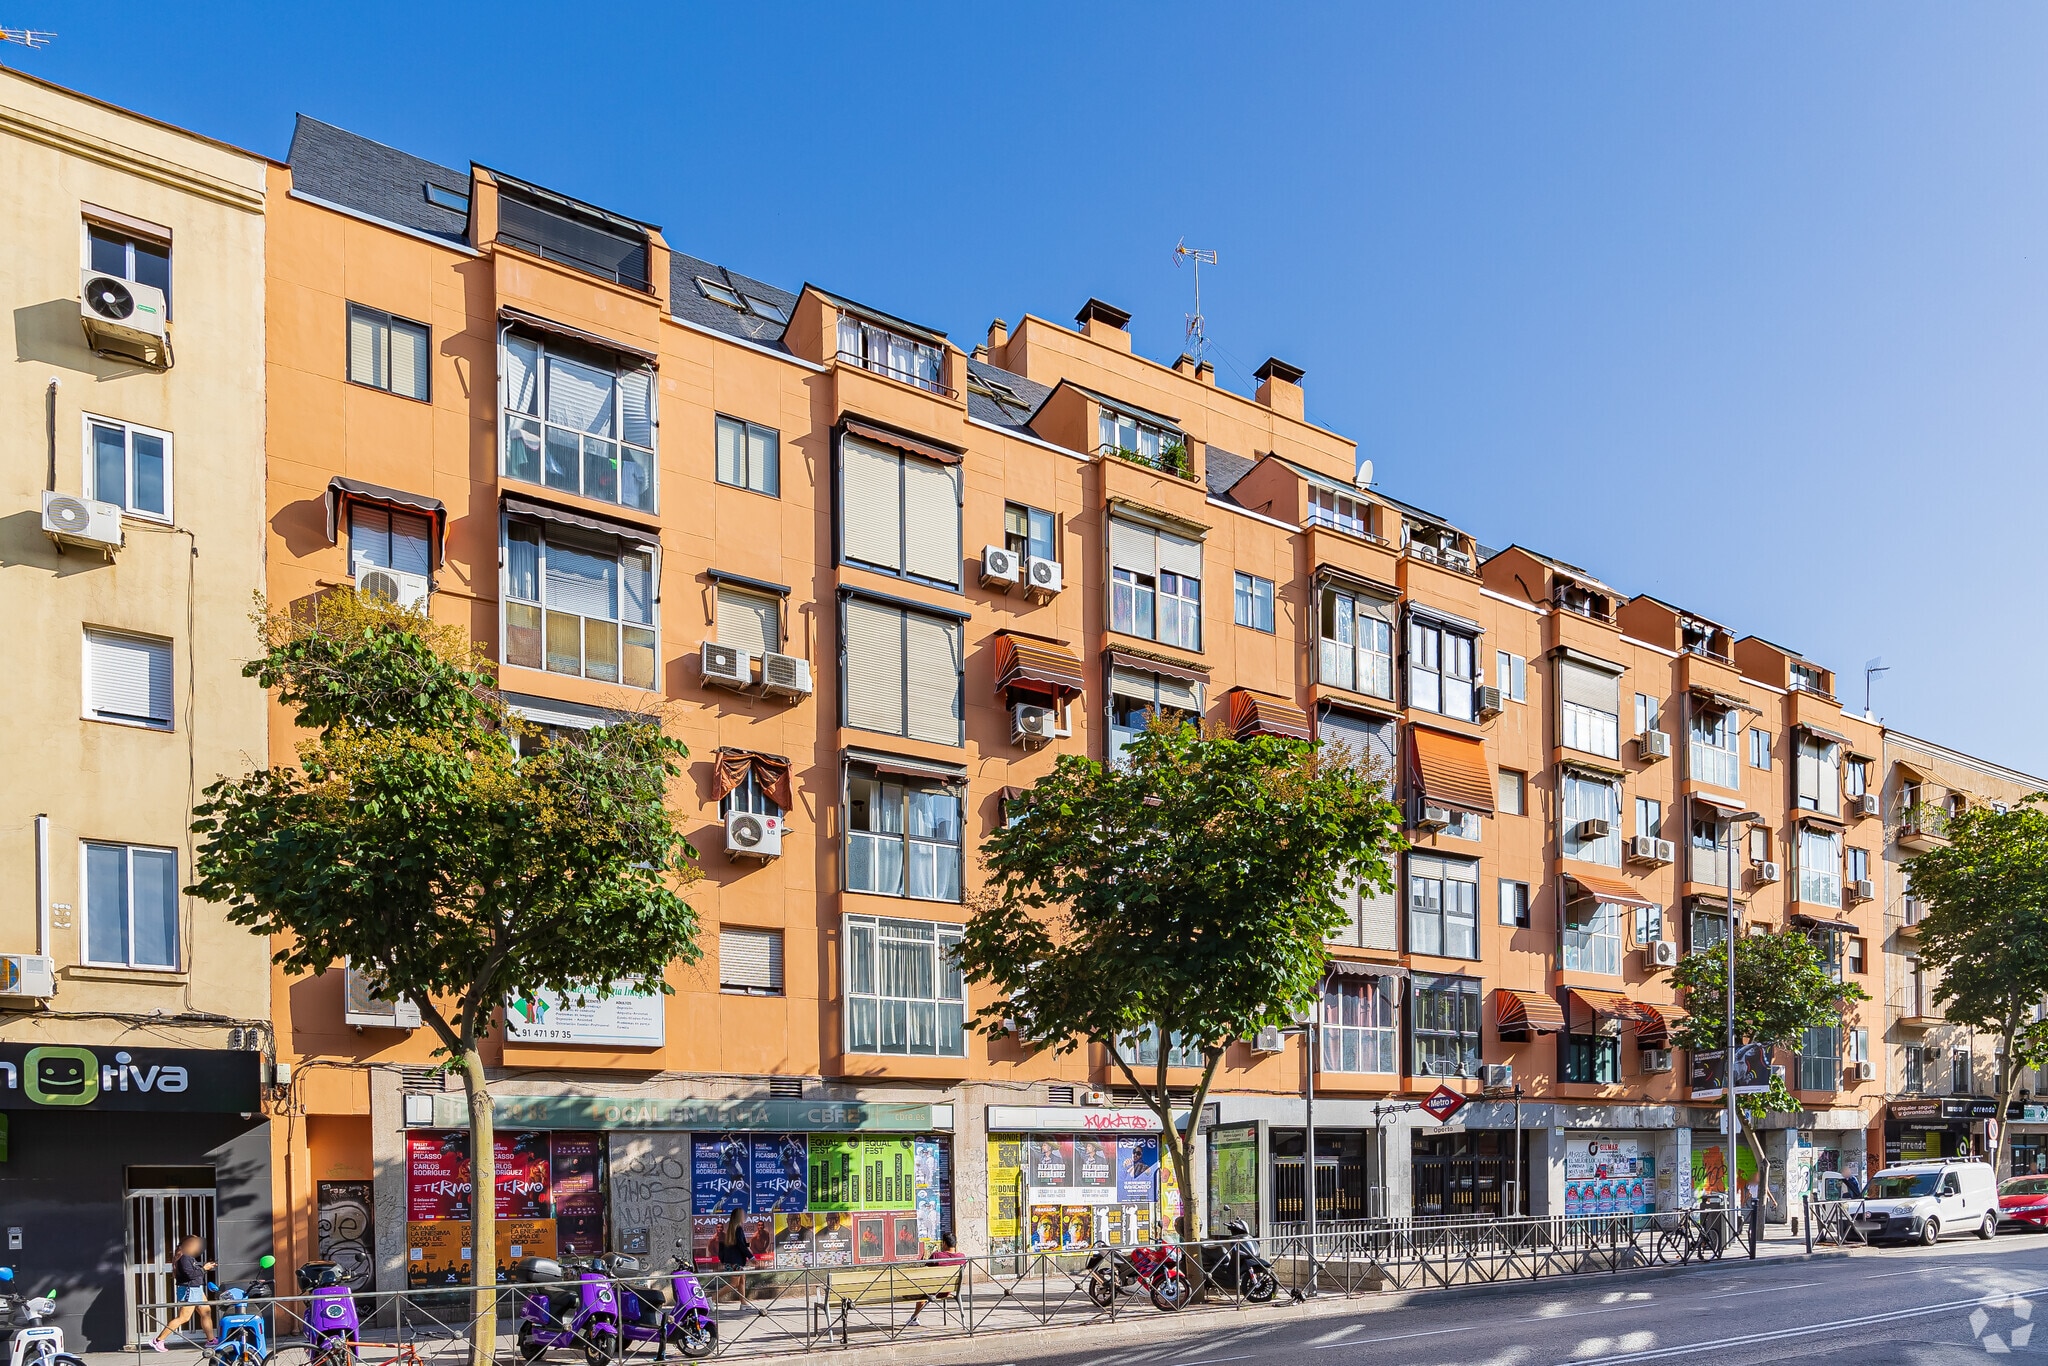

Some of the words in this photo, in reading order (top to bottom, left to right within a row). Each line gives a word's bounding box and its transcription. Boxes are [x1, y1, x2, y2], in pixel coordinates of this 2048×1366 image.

[534, 1030, 548, 1038] 471
[550, 1030, 560, 1038] 97
[562, 1030, 572, 1038] 35
[1430, 1099, 1450, 1108] Metro
[592, 1106, 664, 1122] LOCAL
[670, 1107, 698, 1122] EN
[707, 1108, 769, 1123] VENTA
[808, 1109, 860, 1123] CBRE
[895, 1112, 926, 1121] cbre.es
[414, 1180, 472, 1197] ETERNO
[496, 1180, 543, 1196] TERNO
[697, 1178, 744, 1193] ETERNO
[756, 1178, 801, 1192] ETERNO
[744, 1214, 772, 1223] ARIM
